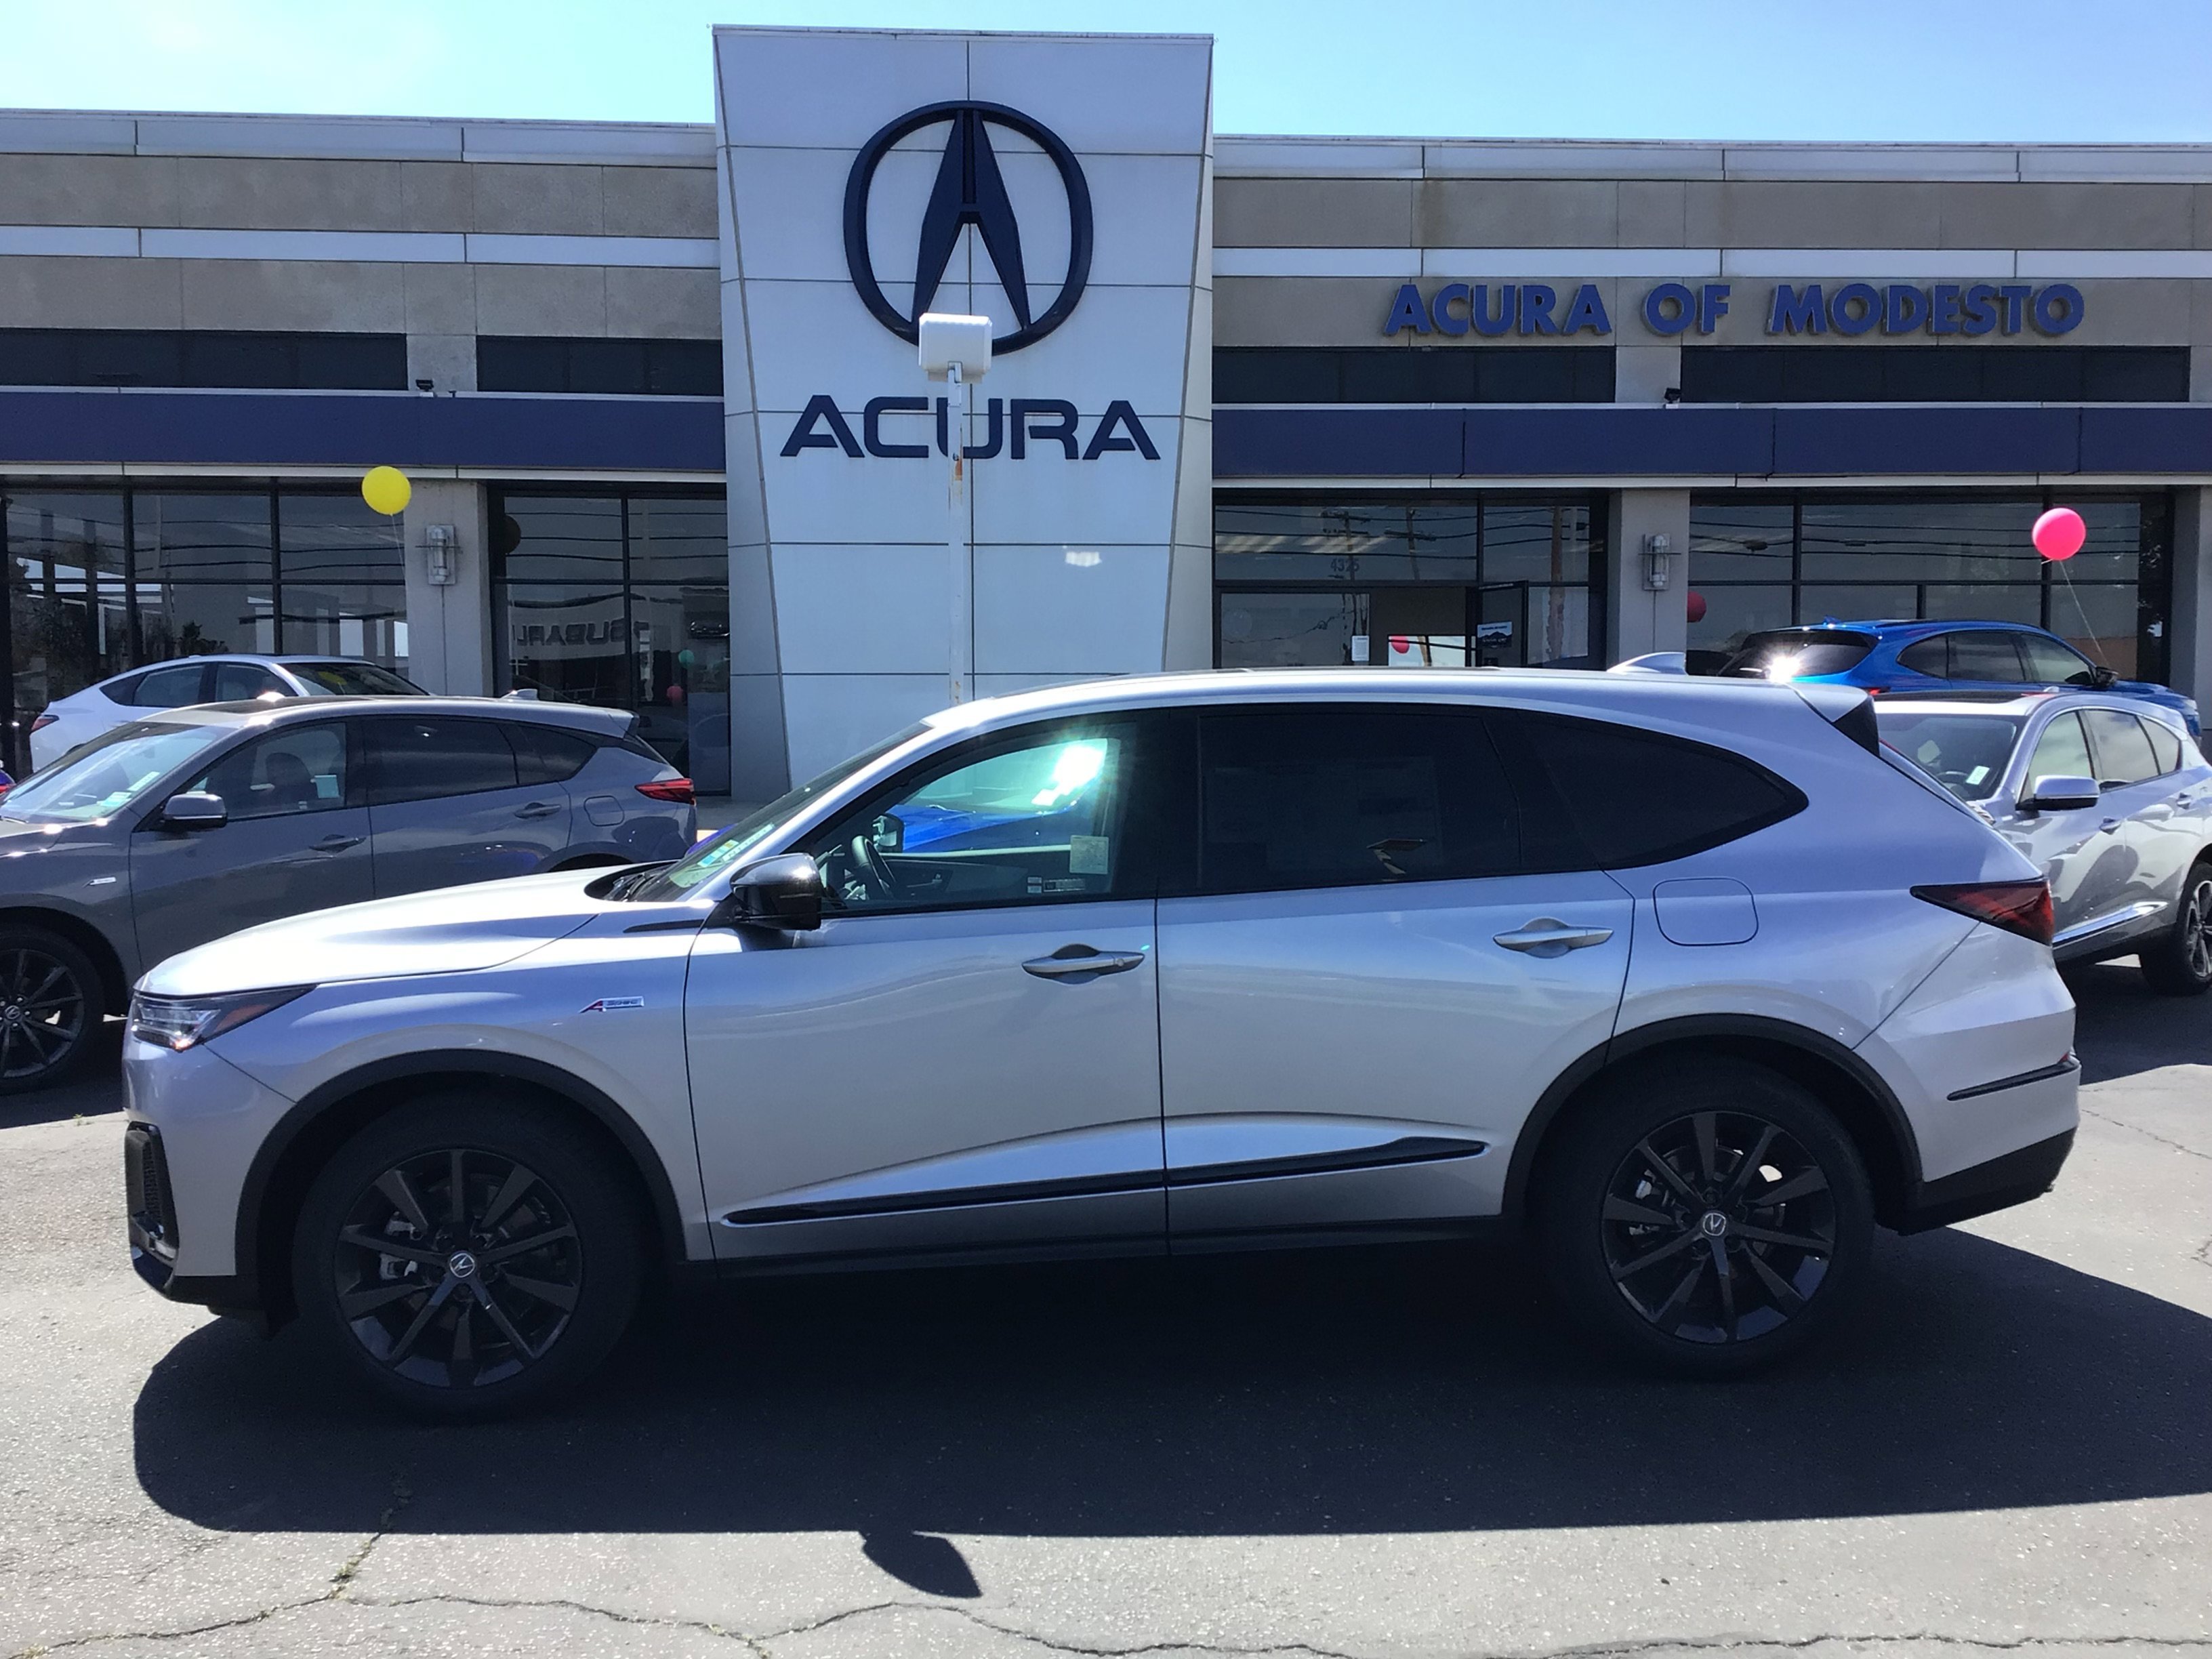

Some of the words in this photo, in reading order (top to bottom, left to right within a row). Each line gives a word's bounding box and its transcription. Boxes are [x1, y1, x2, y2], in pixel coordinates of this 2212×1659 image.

[1385, 283, 1613, 335] ACURA
[1645, 283, 1731, 334] OF
[1769, 283, 2085, 335] MODESTO
[779, 394, 1161, 460] ACURA
